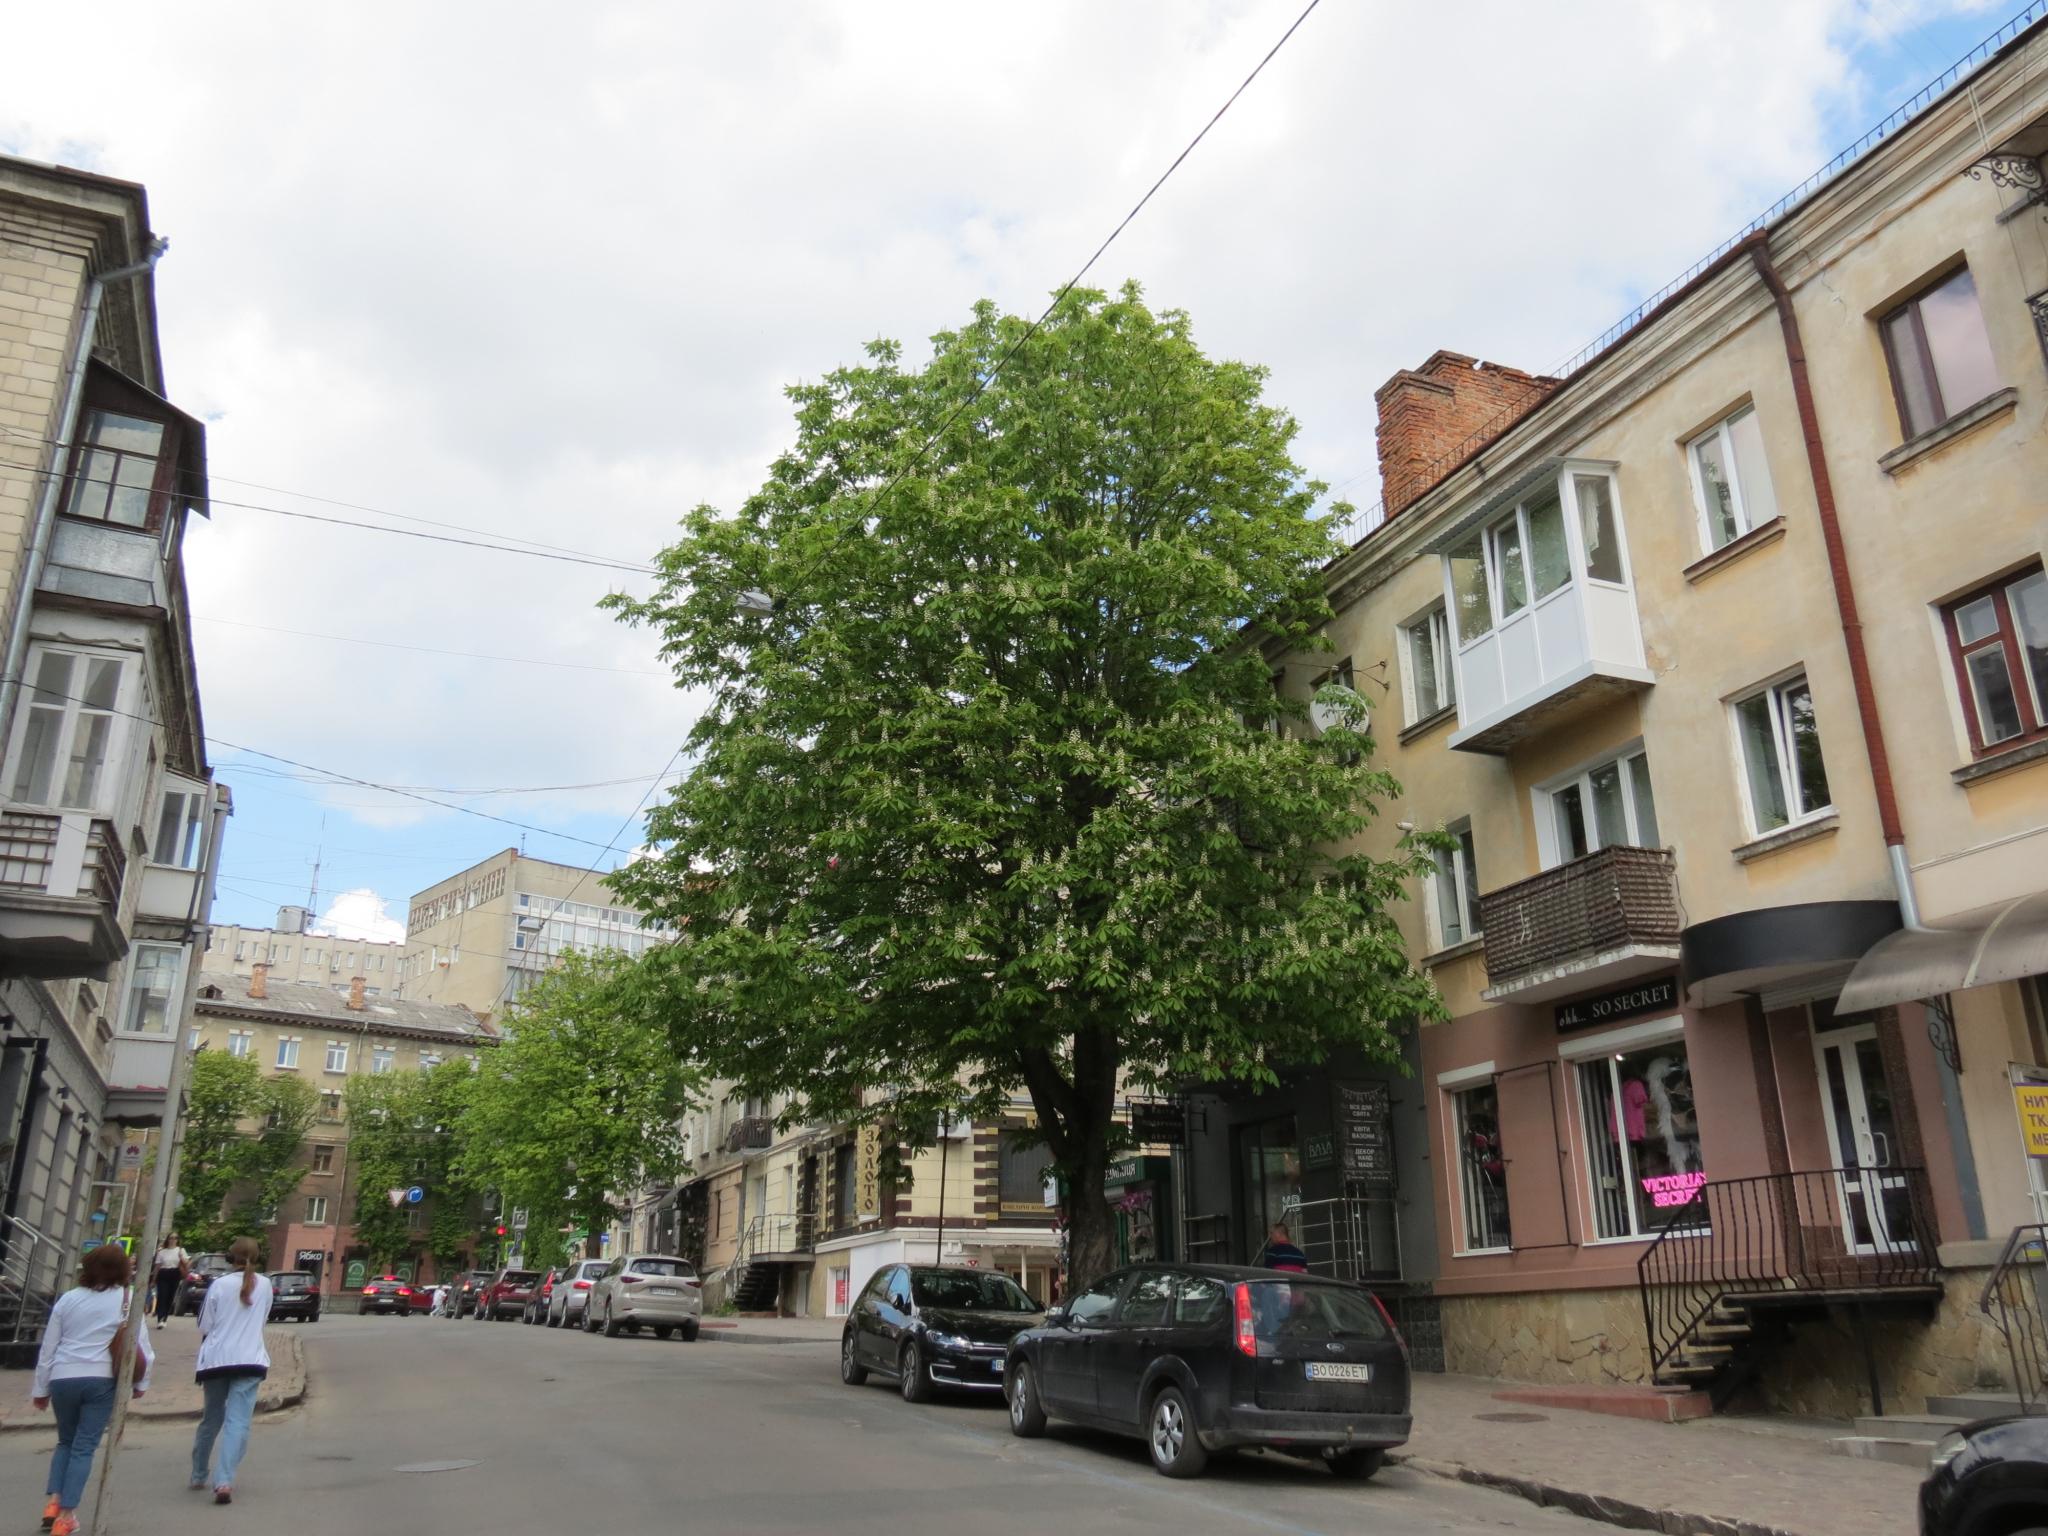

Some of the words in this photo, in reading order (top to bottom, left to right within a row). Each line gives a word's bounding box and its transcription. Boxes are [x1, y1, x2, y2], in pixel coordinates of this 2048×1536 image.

[1592, 1001, 1612, 1018] SO
[1614, 984, 1671, 1012] SECRET
[2028, 1113, 2048, 1128] ТК
[864, 1129, 875, 1210] ЗОЛОТО
[1312, 1364, 1327, 1377] BO
[1329, 1365, 1351, 1377] 0226
[1352, 1366, 1367, 1378] ET
